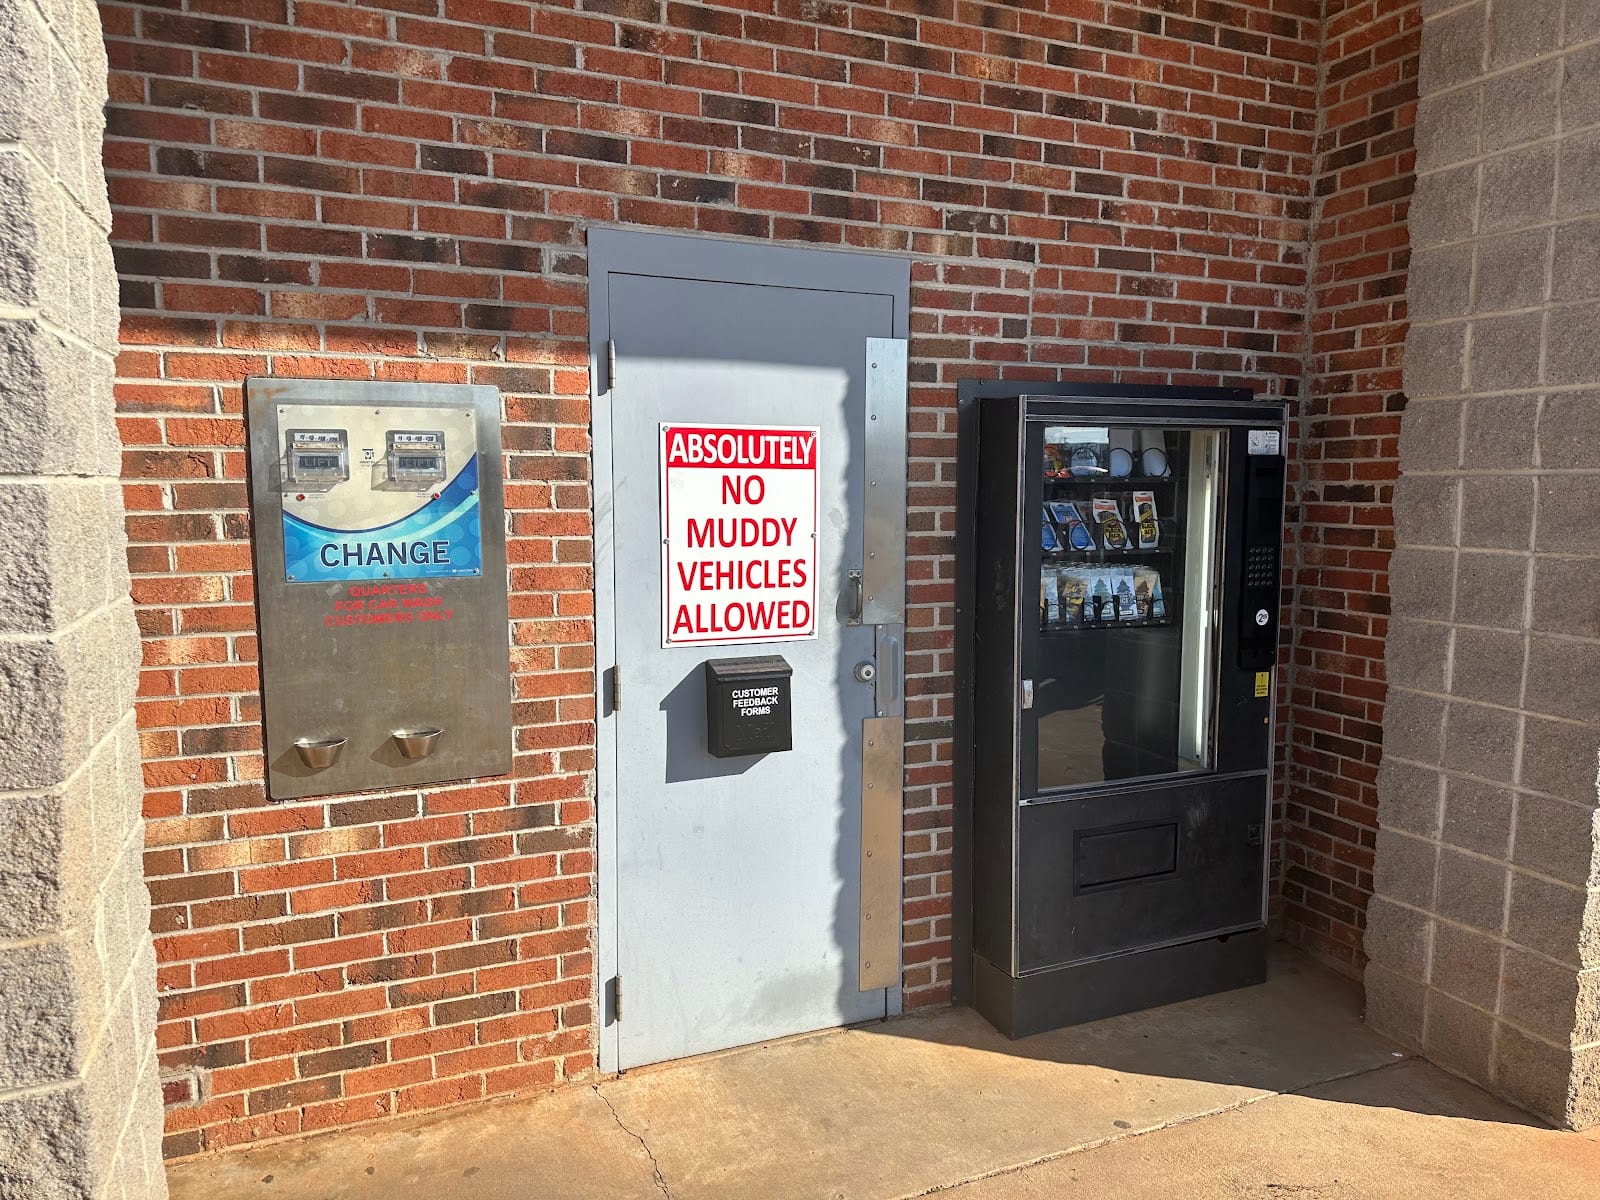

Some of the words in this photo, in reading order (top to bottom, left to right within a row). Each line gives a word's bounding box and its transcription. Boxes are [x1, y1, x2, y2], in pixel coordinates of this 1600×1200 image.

[669, 432, 815, 465] ABSOLUTELY
[722, 475, 765, 505] NO
[687, 517, 798, 548] MUDDY
[320, 540, 450, 568] CHANGE
[677, 558, 807, 591] VEHICLES
[349, 583, 428, 597] QUARTERS
[335, 600, 364, 612] FOR
[368, 598, 399, 610] CAR
[401, 596, 443, 609] WASH
[324, 611, 413, 627] CUSTOMERS
[416, 609, 453, 623] ONLY
[673, 600, 811, 635] ALLOWED
[731, 686, 779, 699] CUSTOMER
[732, 696, 779, 708] FEEDBACK
[740, 706, 771, 717] FORMS
